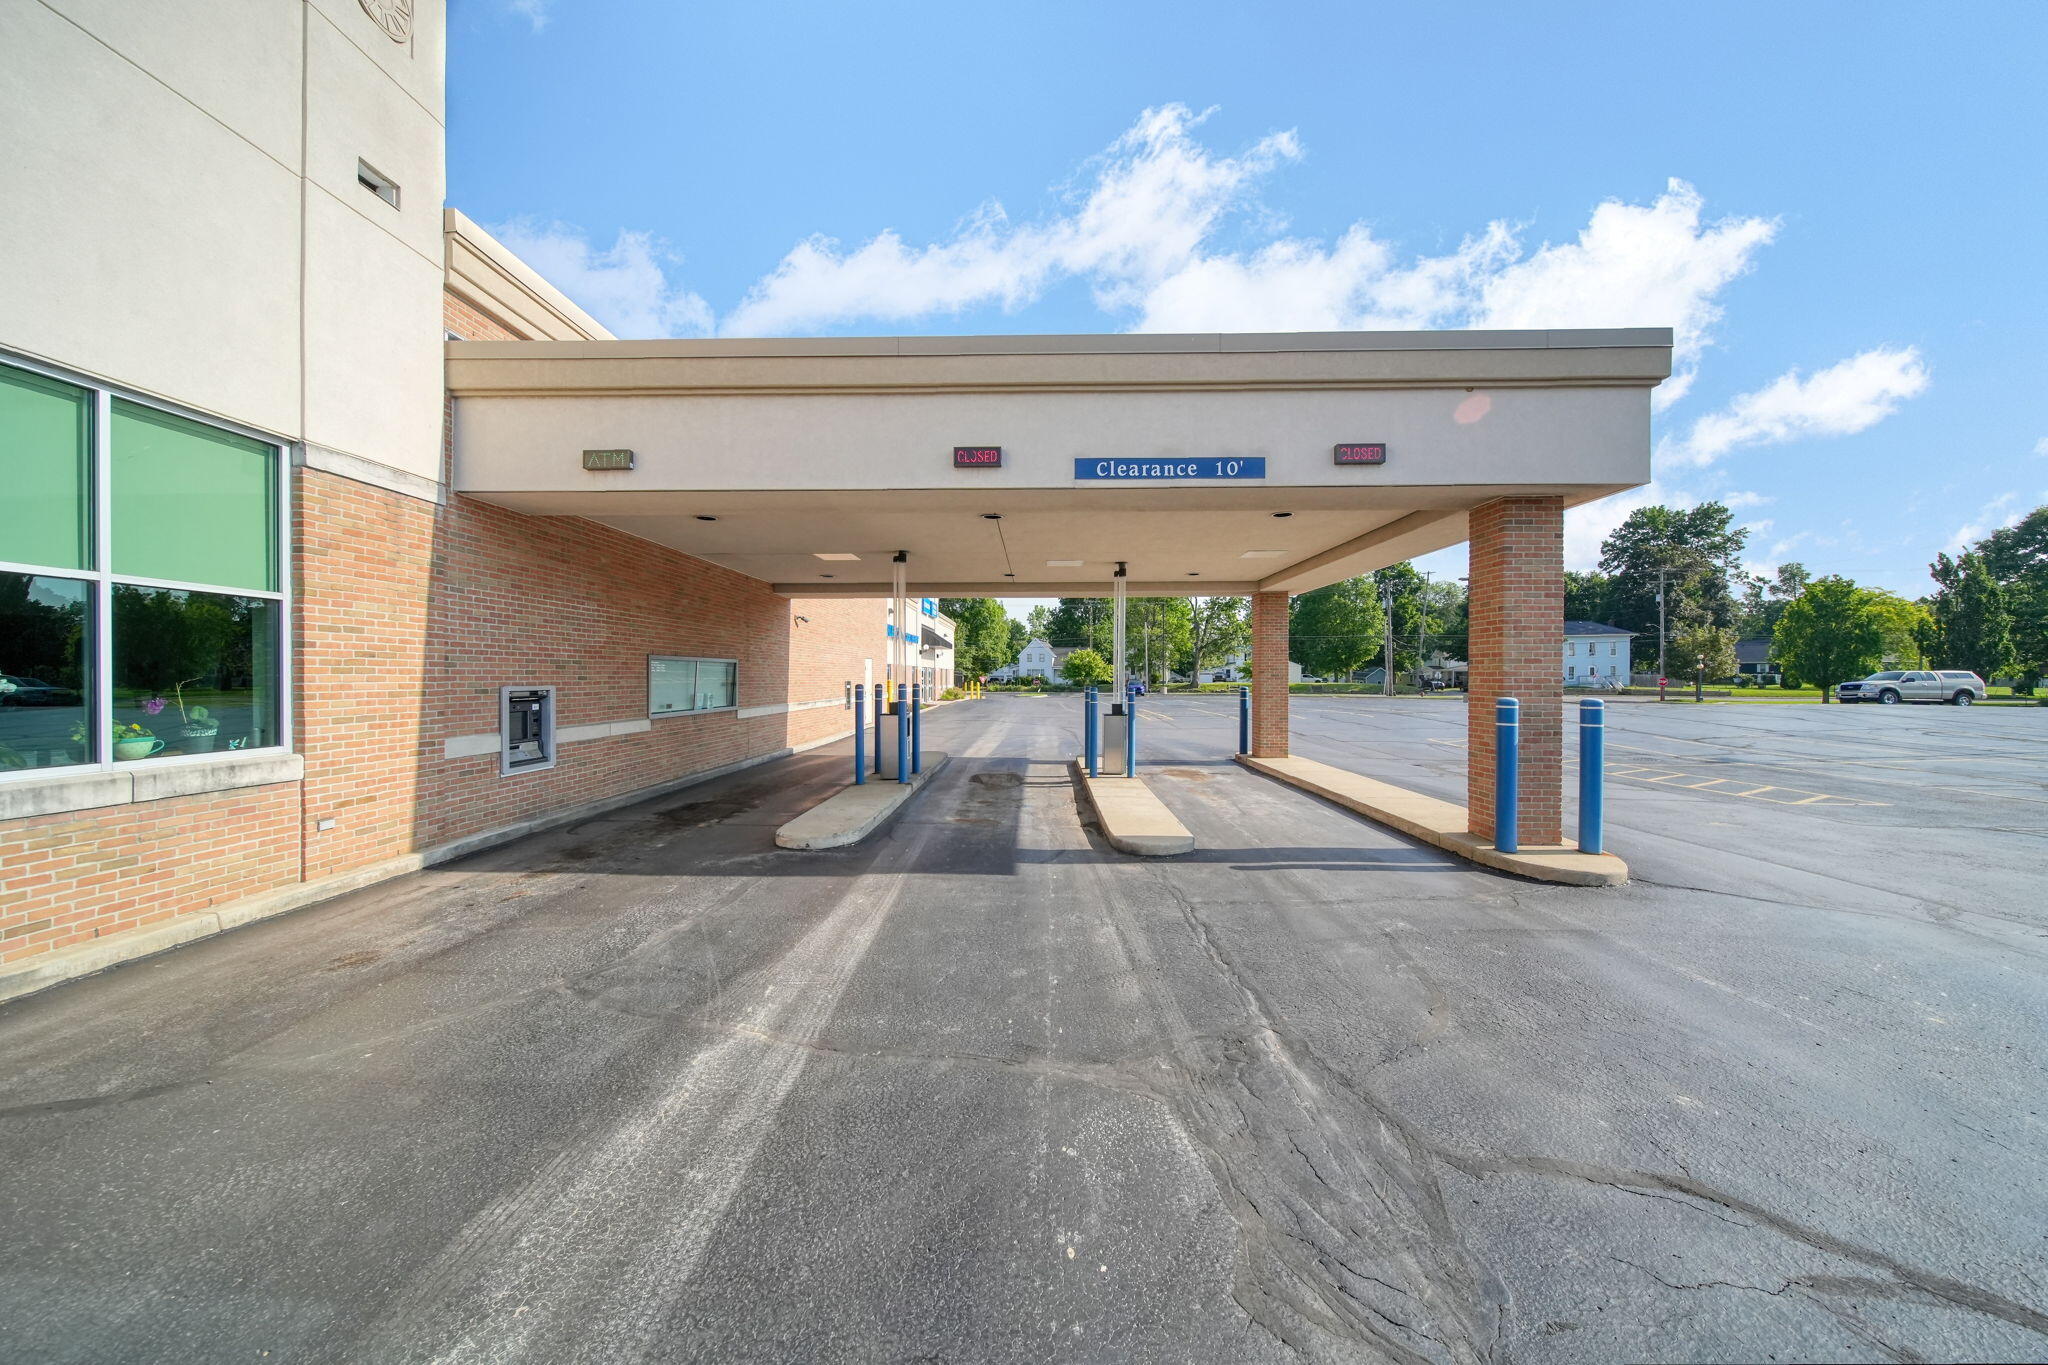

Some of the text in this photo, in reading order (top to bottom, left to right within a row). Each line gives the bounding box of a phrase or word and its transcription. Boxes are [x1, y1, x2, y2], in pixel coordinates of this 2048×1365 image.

[587, 452, 626, 467] ATM
[957, 450, 998, 463] CLOSED
[1340, 447, 1382, 460] CLOSED
[1096, 460, 1244, 477] Clearance 10'
